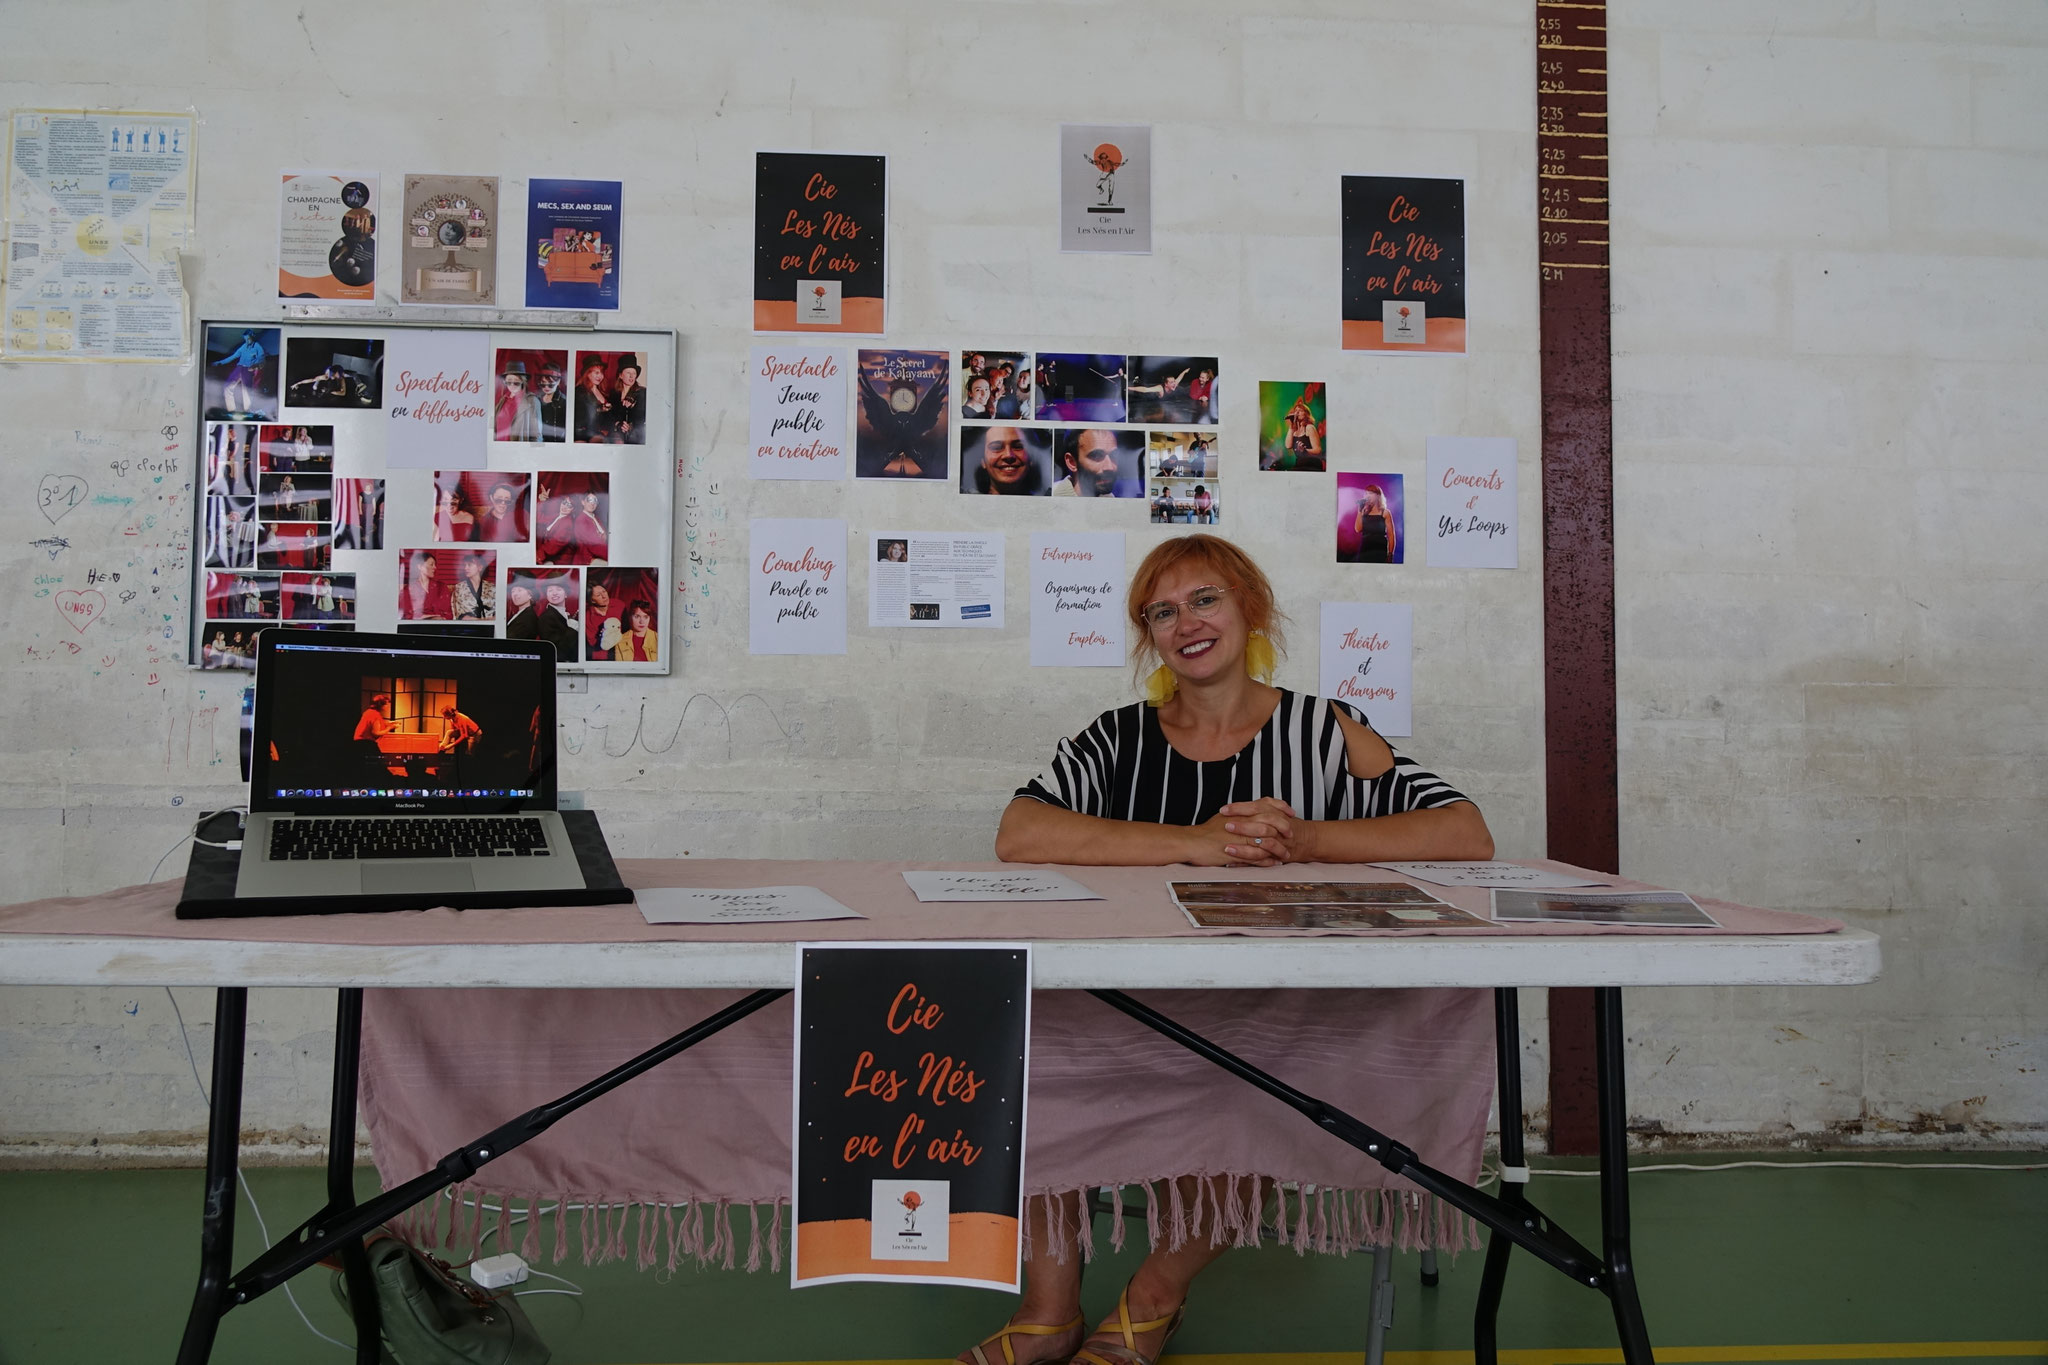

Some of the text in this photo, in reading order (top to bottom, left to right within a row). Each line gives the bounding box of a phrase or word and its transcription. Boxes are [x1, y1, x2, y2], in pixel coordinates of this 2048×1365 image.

[805, 173, 838, 201] Cie
[287, 196, 341, 204] CHAMPAGNE
[537, 202, 560, 210] MECS,
[575, 203, 592, 211] AND
[1388, 195, 1420, 223] Cie
[781, 209, 862, 241] Les Nés
[1366, 231, 1443, 262] Les Nés
[780, 254, 803, 270] en
[1366, 276, 1388, 291] en
[761, 355, 838, 382] Spectacle
[874, 367, 936, 381] de Kalayaan
[884, 357, 926, 369] Le Secret
[395, 370, 484, 398] Spectacles
[778, 385, 821, 404] Jeune
[392, 400, 486, 424] en diffusion
[771, 408, 825, 437] public
[758, 439, 840, 461] en création
[1442, 467, 1504, 490] Concerts
[1438, 515, 1508, 538] Ysé Loops
[762, 546, 837, 581] Coaching
[1041, 547, 1094, 563] Entreprises
[769, 579, 829, 598] Parole en
[1044, 581, 1112, 598] Organismes de
[64, 601, 93, 616] UNSS
[777, 600, 819, 623] public
[1055, 598, 1102, 612] formation
[1339, 627, 1390, 651] Théâtre
[1358, 657, 1372, 675] et
[1337, 679, 1397, 700] Chansons
[886, 982, 944, 1034] Cie
[844, 1051, 985, 1106] Les Nés
[843, 1135, 883, 1163] en
